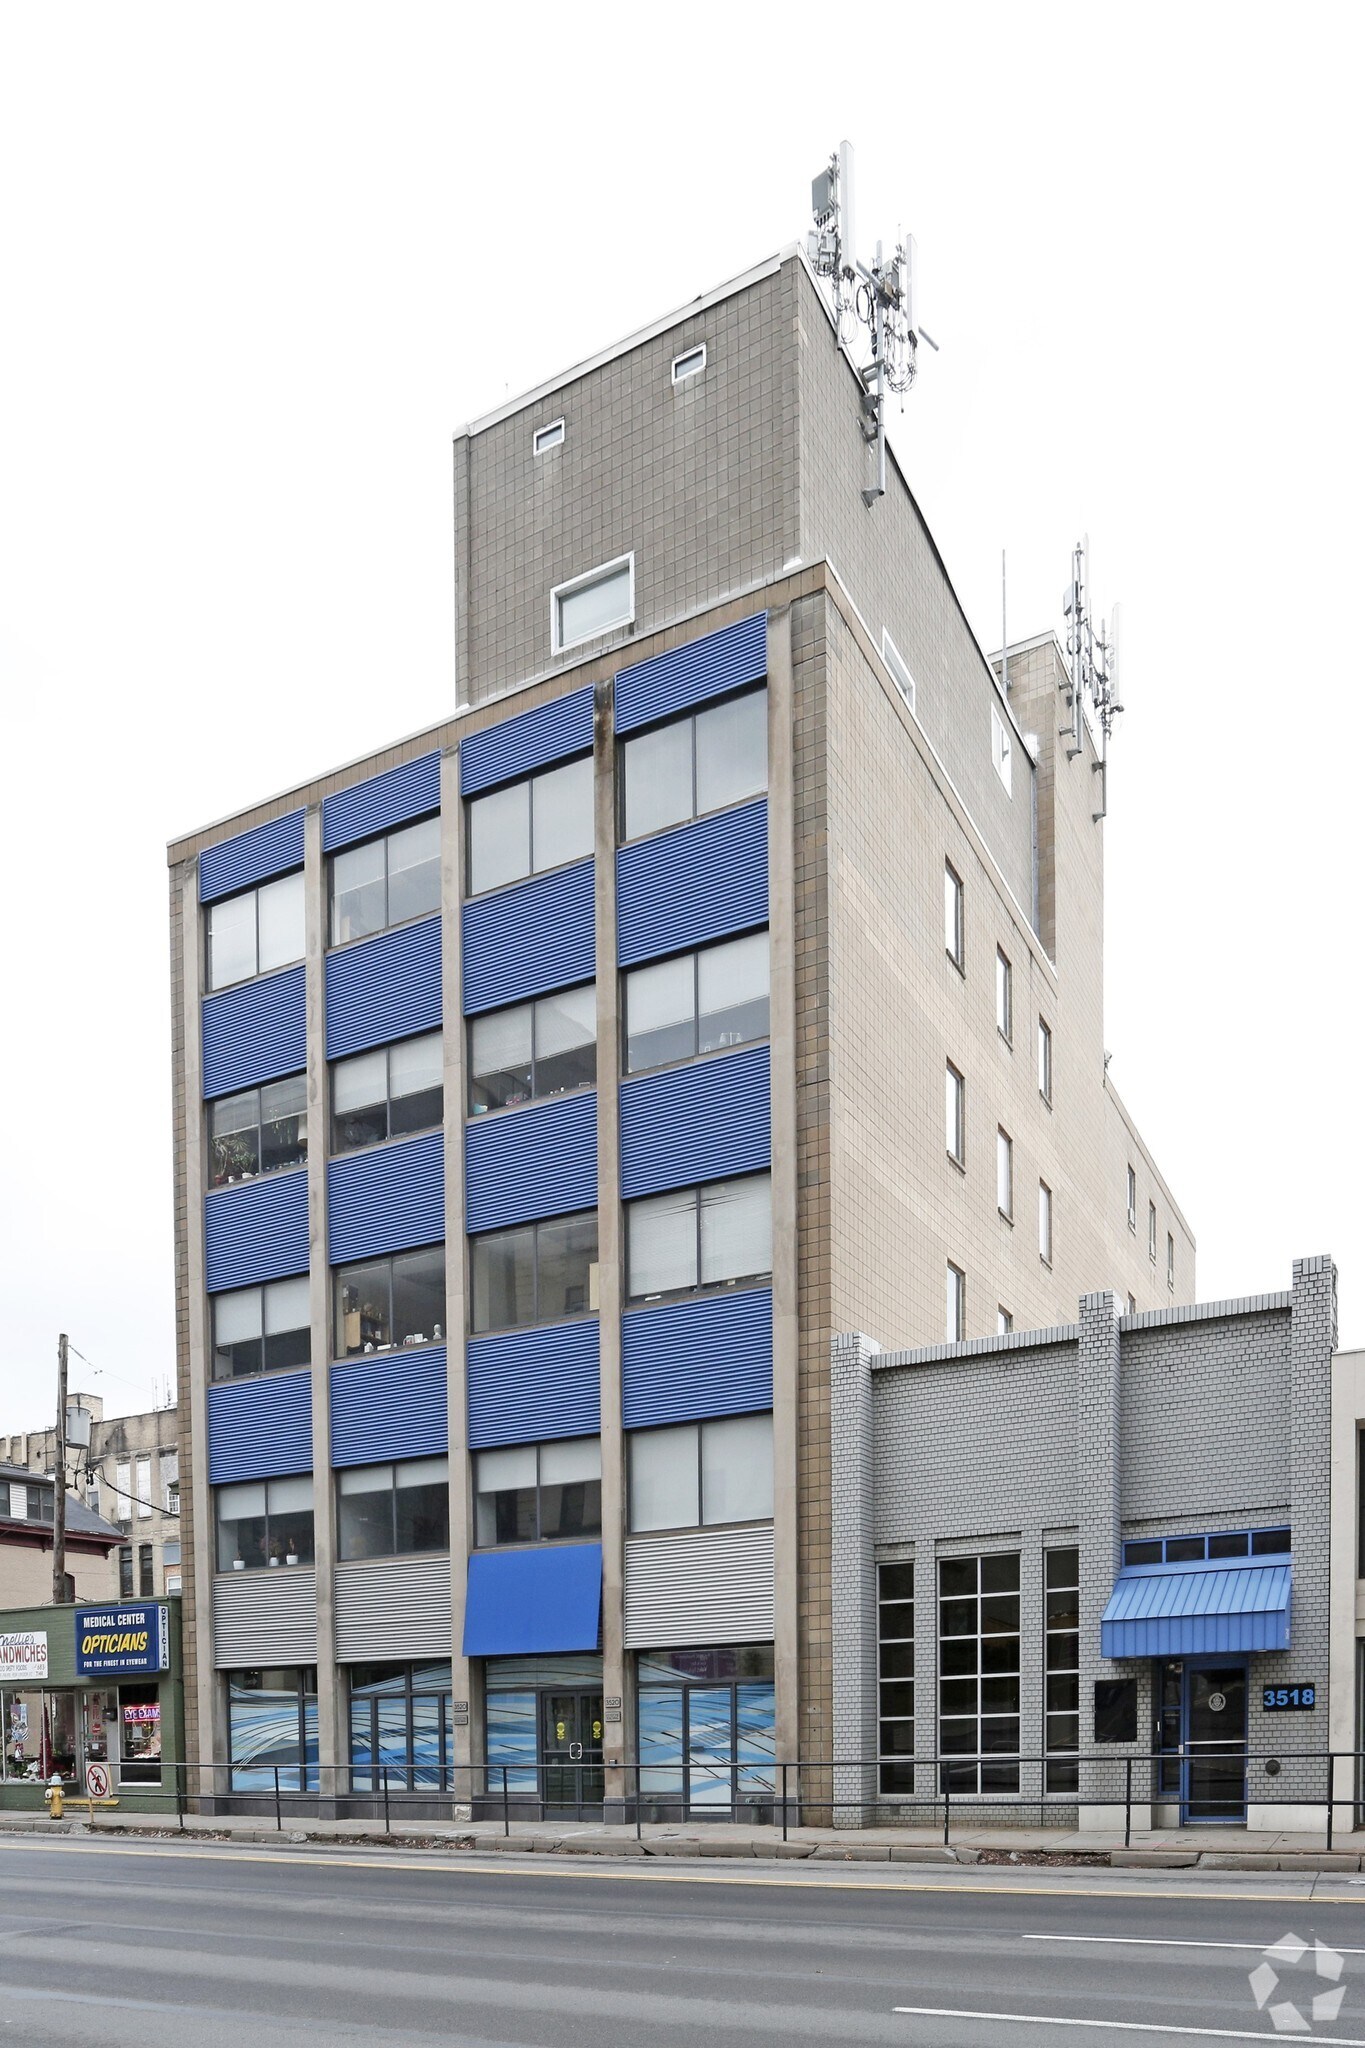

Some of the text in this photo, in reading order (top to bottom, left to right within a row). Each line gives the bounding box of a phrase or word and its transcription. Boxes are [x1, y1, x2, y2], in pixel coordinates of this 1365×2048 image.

[83, 1613, 145, 1628] MEDICAL CENTER
[82, 1631, 148, 1655] OPTICIANS
[0, 1643, 47, 1663] ANDWICHES
[103, 1659, 119, 1667] FINEST
[126, 1658, 147, 1666] EYEWEAR
[1263, 1688, 1314, 1706] 3518
[124, 1709, 138, 1720] EYE
